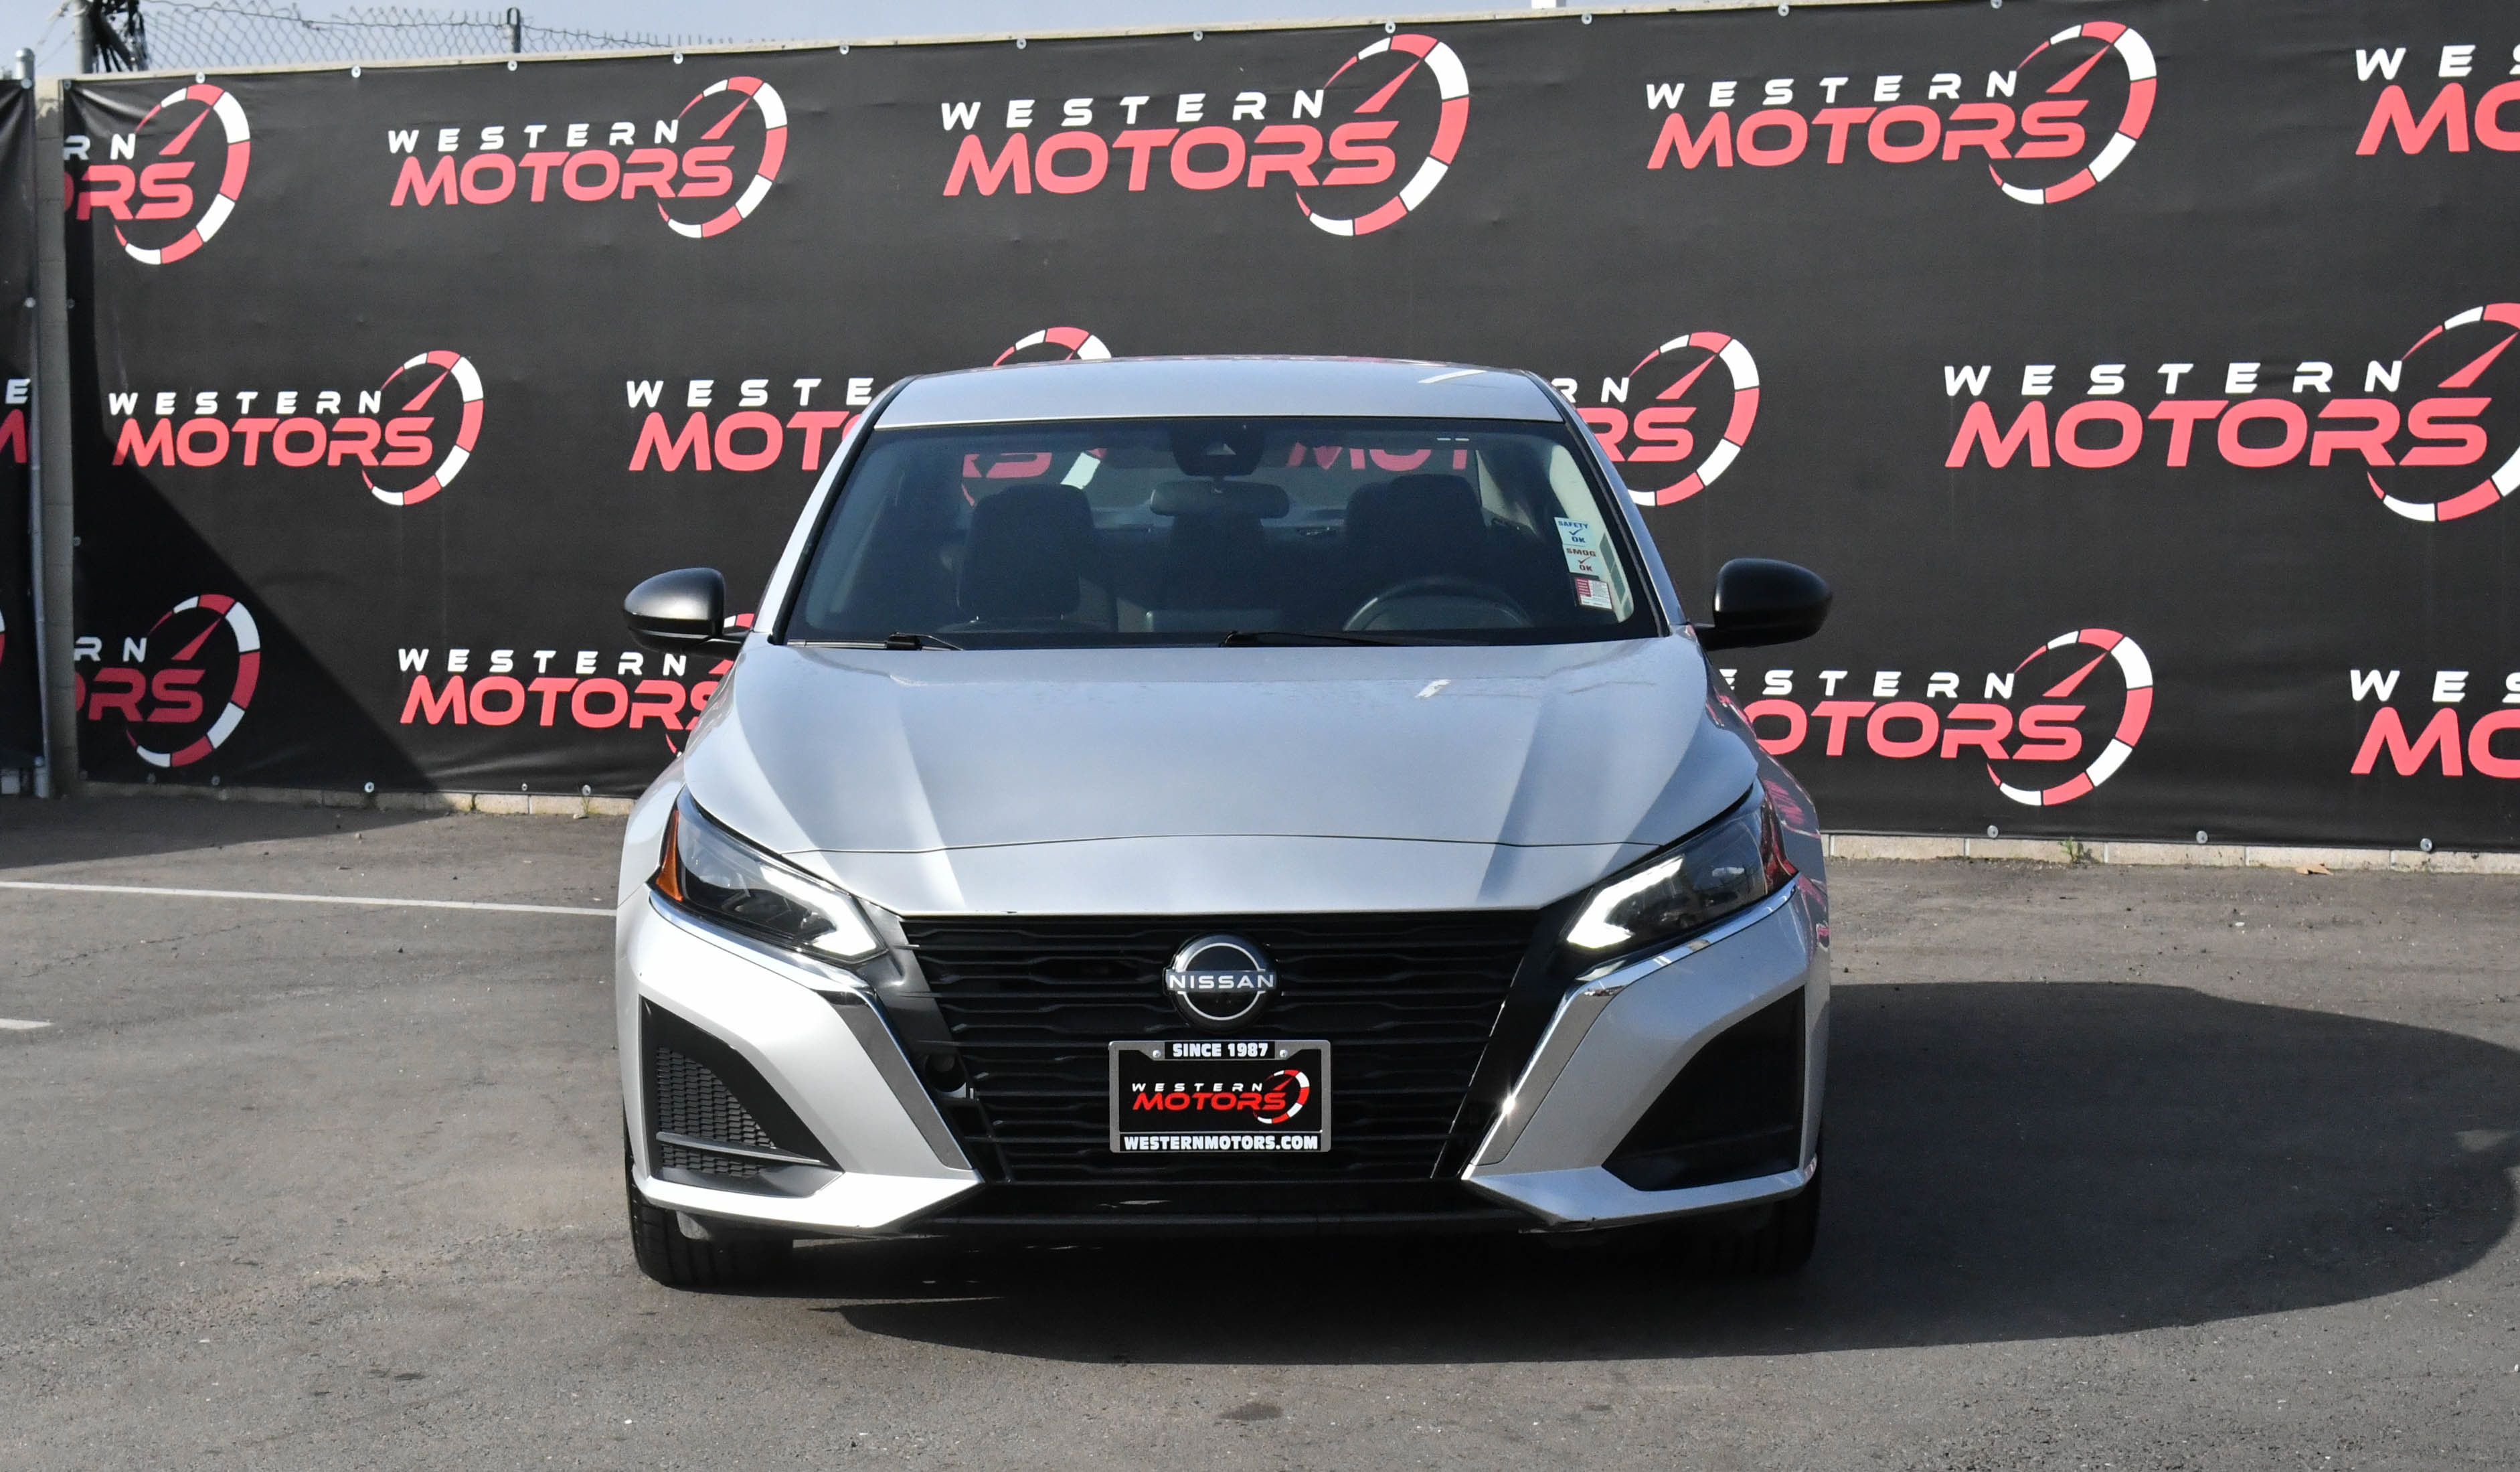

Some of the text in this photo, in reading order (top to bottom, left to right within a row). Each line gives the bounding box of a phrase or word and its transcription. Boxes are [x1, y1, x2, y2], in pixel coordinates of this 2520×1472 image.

[1646, 71, 2017, 110] WESTERN
[941, 89, 1325, 131] WESTERN
[388, 119, 679, 154] WESTERN
[1647, 99, 2090, 170] MOTORS
[943, 120, 1400, 197] MOTORS
[390, 145, 736, 208] MOTORS
[626, 378, 874, 408] WESTE
[1944, 360, 2403, 397] WESTERN
[108, 390, 382, 416] WESTERN
[112, 416, 434, 468] MOTORS
[628, 410, 861, 472] MOT
[1944, 396, 2493, 469] MOTORS
[1558, 520, 1589, 529] SAFETY
[1566, 548, 1596, 557] SMOG
[398, 648, 687, 677] WESTERN
[1719, 668, 2015, 700] STERN
[1743, 698, 2086, 761] OTORS
[1169, 975, 1274, 989] NISSAN
[1173, 1042, 1268, 1057] SINCE 1987
[1132, 1082, 1262, 1092] WESTERN
[1132, 1092, 1286, 1111] MOTORS
[1124, 1135, 1318, 1150] WESTERNMOTORS.COM
